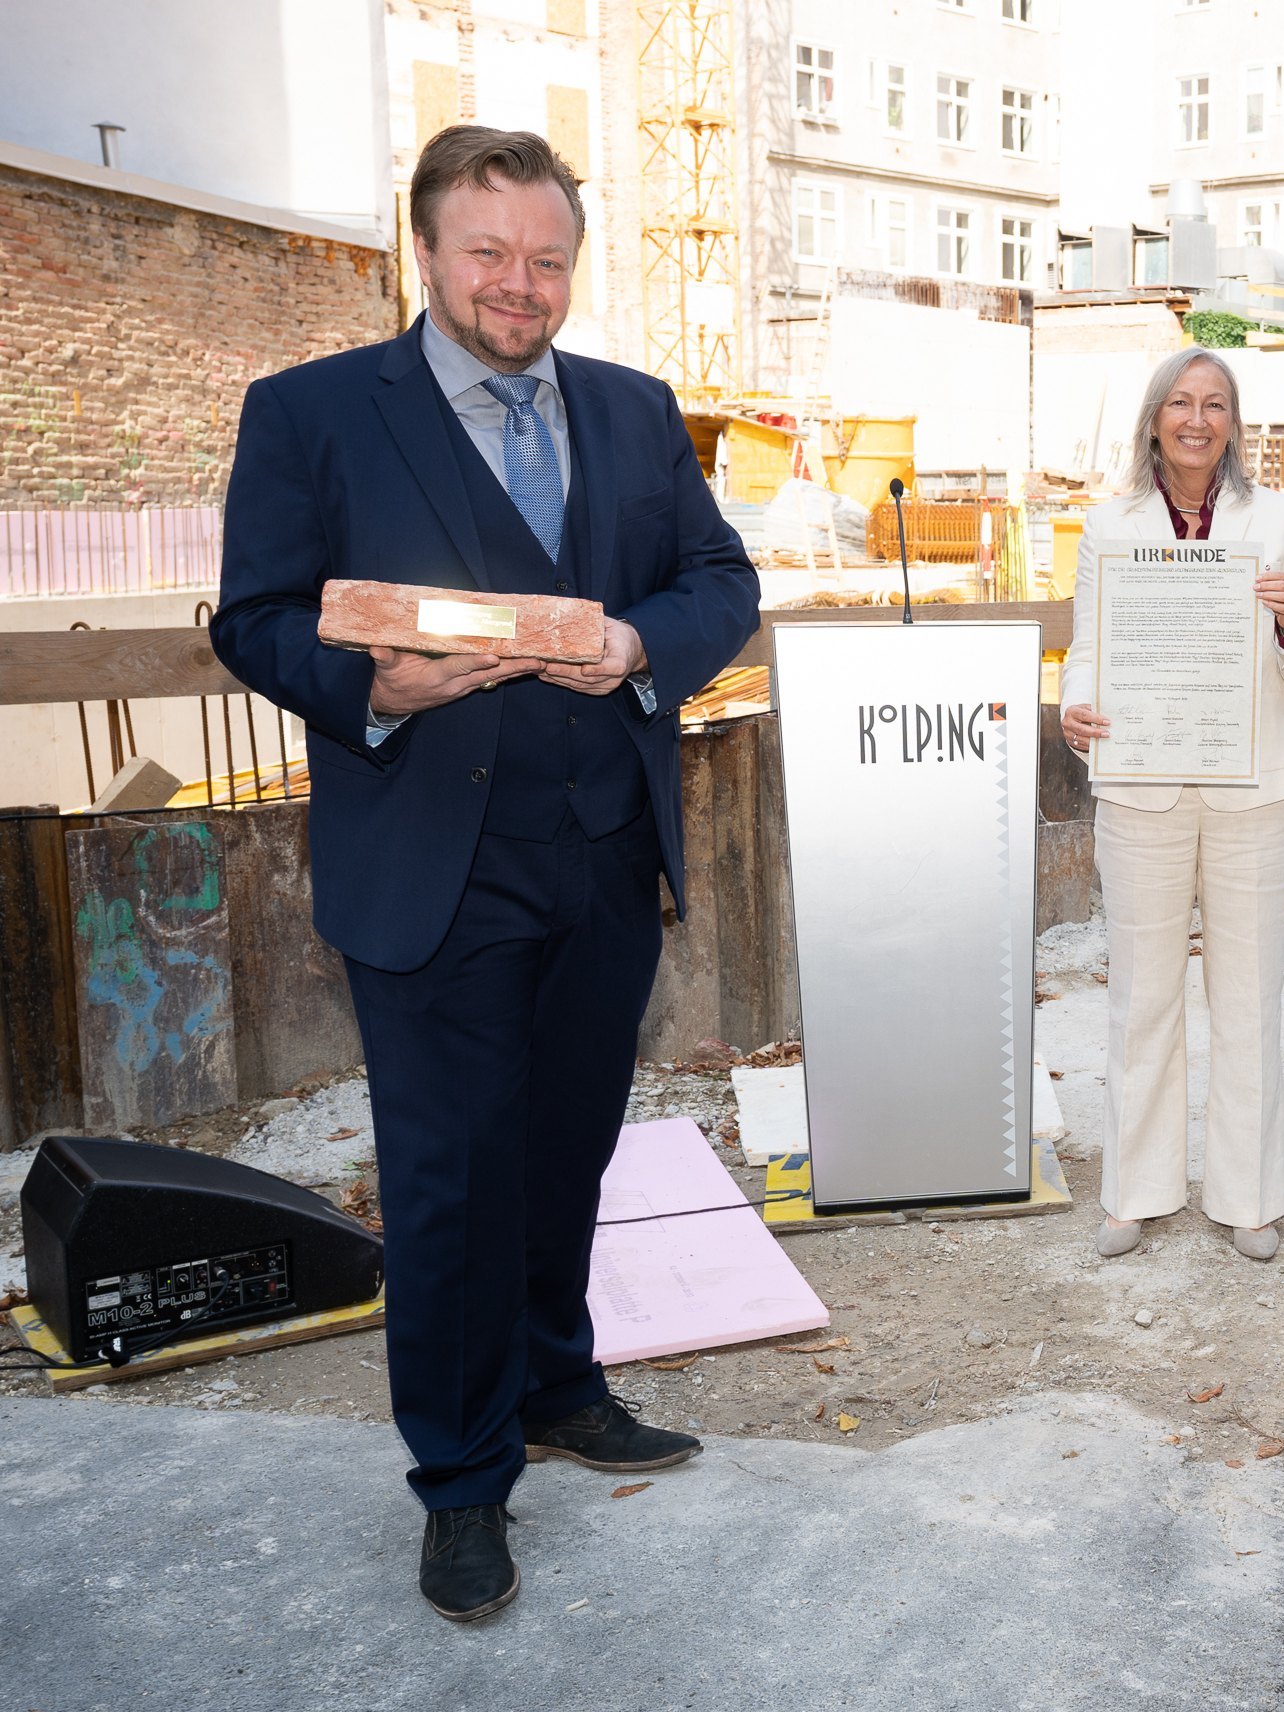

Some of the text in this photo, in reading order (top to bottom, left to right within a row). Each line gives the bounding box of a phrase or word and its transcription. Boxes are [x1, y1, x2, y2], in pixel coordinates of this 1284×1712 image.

[1134, 548, 1226, 562] URKUNDE
[88, 1302, 154, 1326] M10-2
[158, 1292, 206, 1308] PLUS
[180, 1310, 192, 1320] dB
